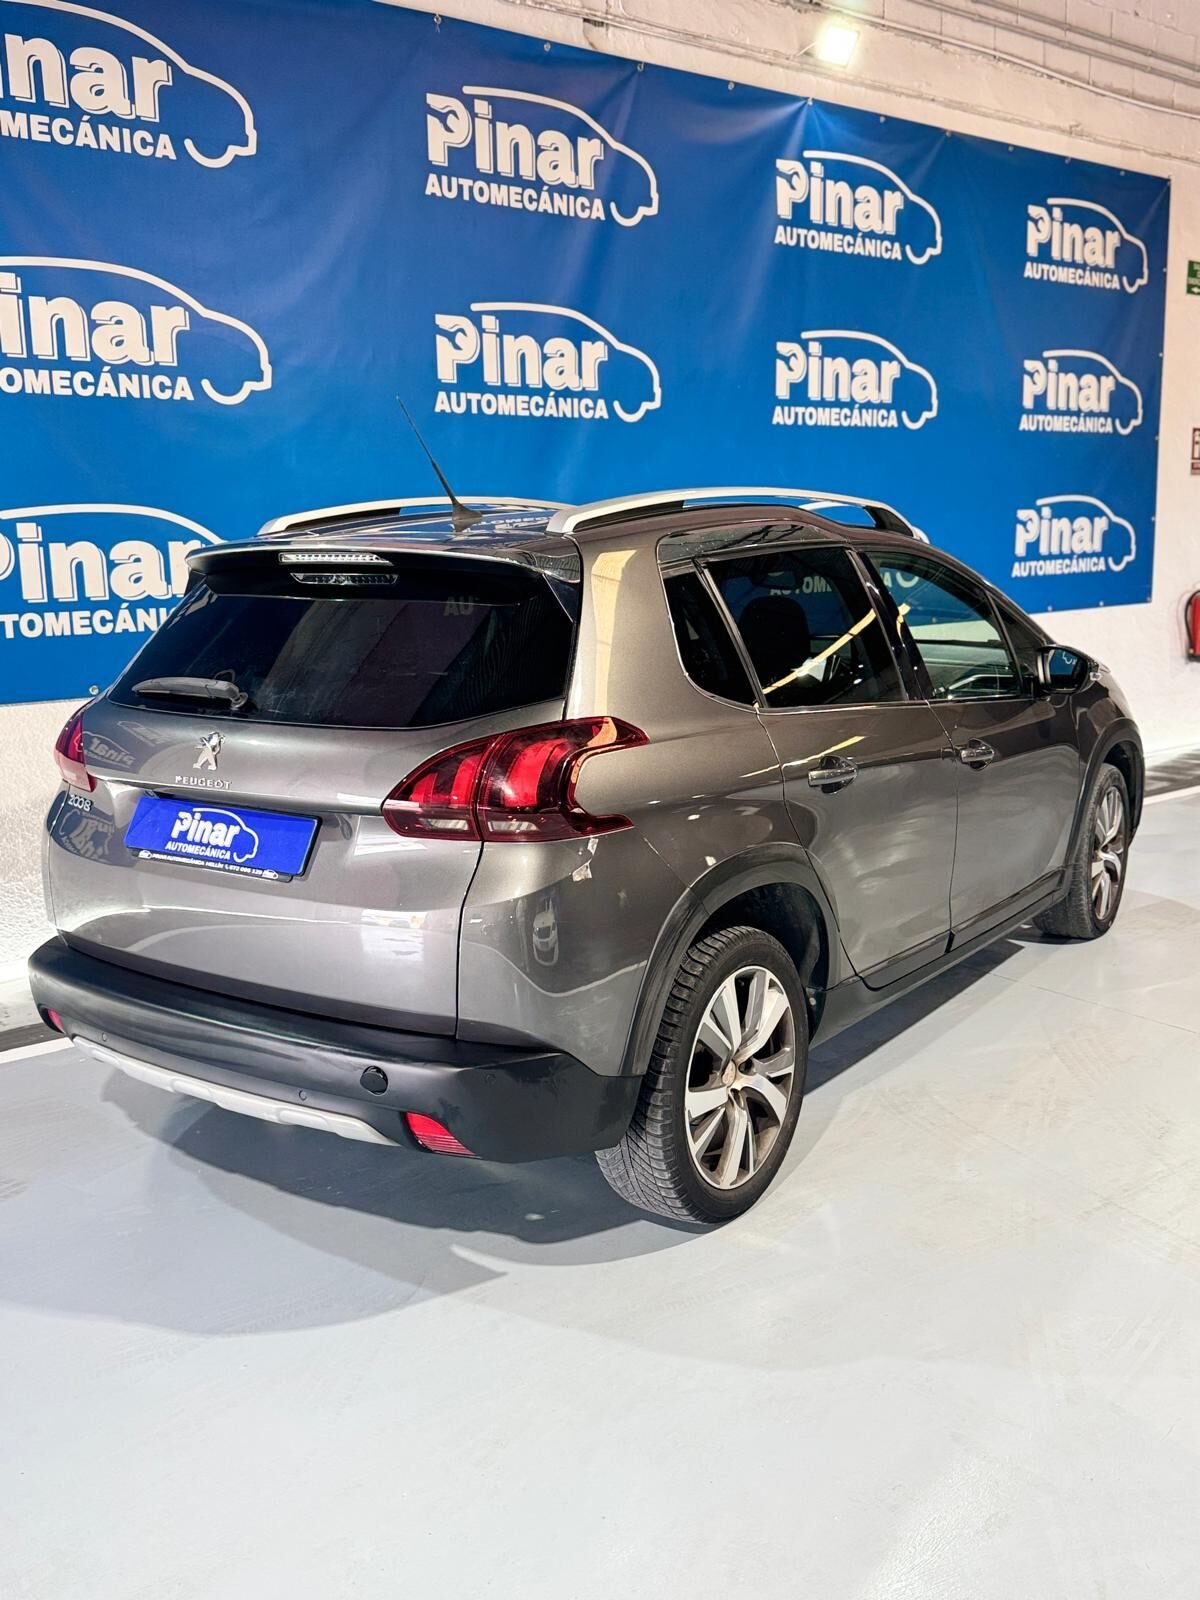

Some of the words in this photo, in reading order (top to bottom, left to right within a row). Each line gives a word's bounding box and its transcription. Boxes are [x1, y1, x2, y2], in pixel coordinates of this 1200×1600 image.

[0, 34, 172, 122] nar
[425, 92, 605, 190] Pinar
[425, 173, 606, 220] AUTOMECÁNICA
[775, 158, 904, 236] Pinar
[774, 225, 902, 261] AUTOMECÁNICA
[1026, 204, 1121, 268] Pinar
[1023, 261, 1120, 290] AUTOMECÁNICA
[434, 313, 609, 391] Pinar
[775, 341, 901, 403] Pinar
[1022, 358, 1115, 412] Pinar
[434, 391, 609, 419] AUTOMECÁNICA
[772, 404, 898, 428] AUTOMECÁNICA
[1019, 413, 1113, 433] AUTOMECÁNICA
[1014, 506, 1108, 557] Pinar
[1011, 554, 1106, 578] AUTOMECÁNICA
[0, 603, 176, 638] TOMECÁNI
[175, 775, 231, 789] PEUGEOT
[68, 795, 91, 811] 2008
[171, 811, 240, 848] Pinar
[165, 841, 231, 860] AUTOMECÁNICA
